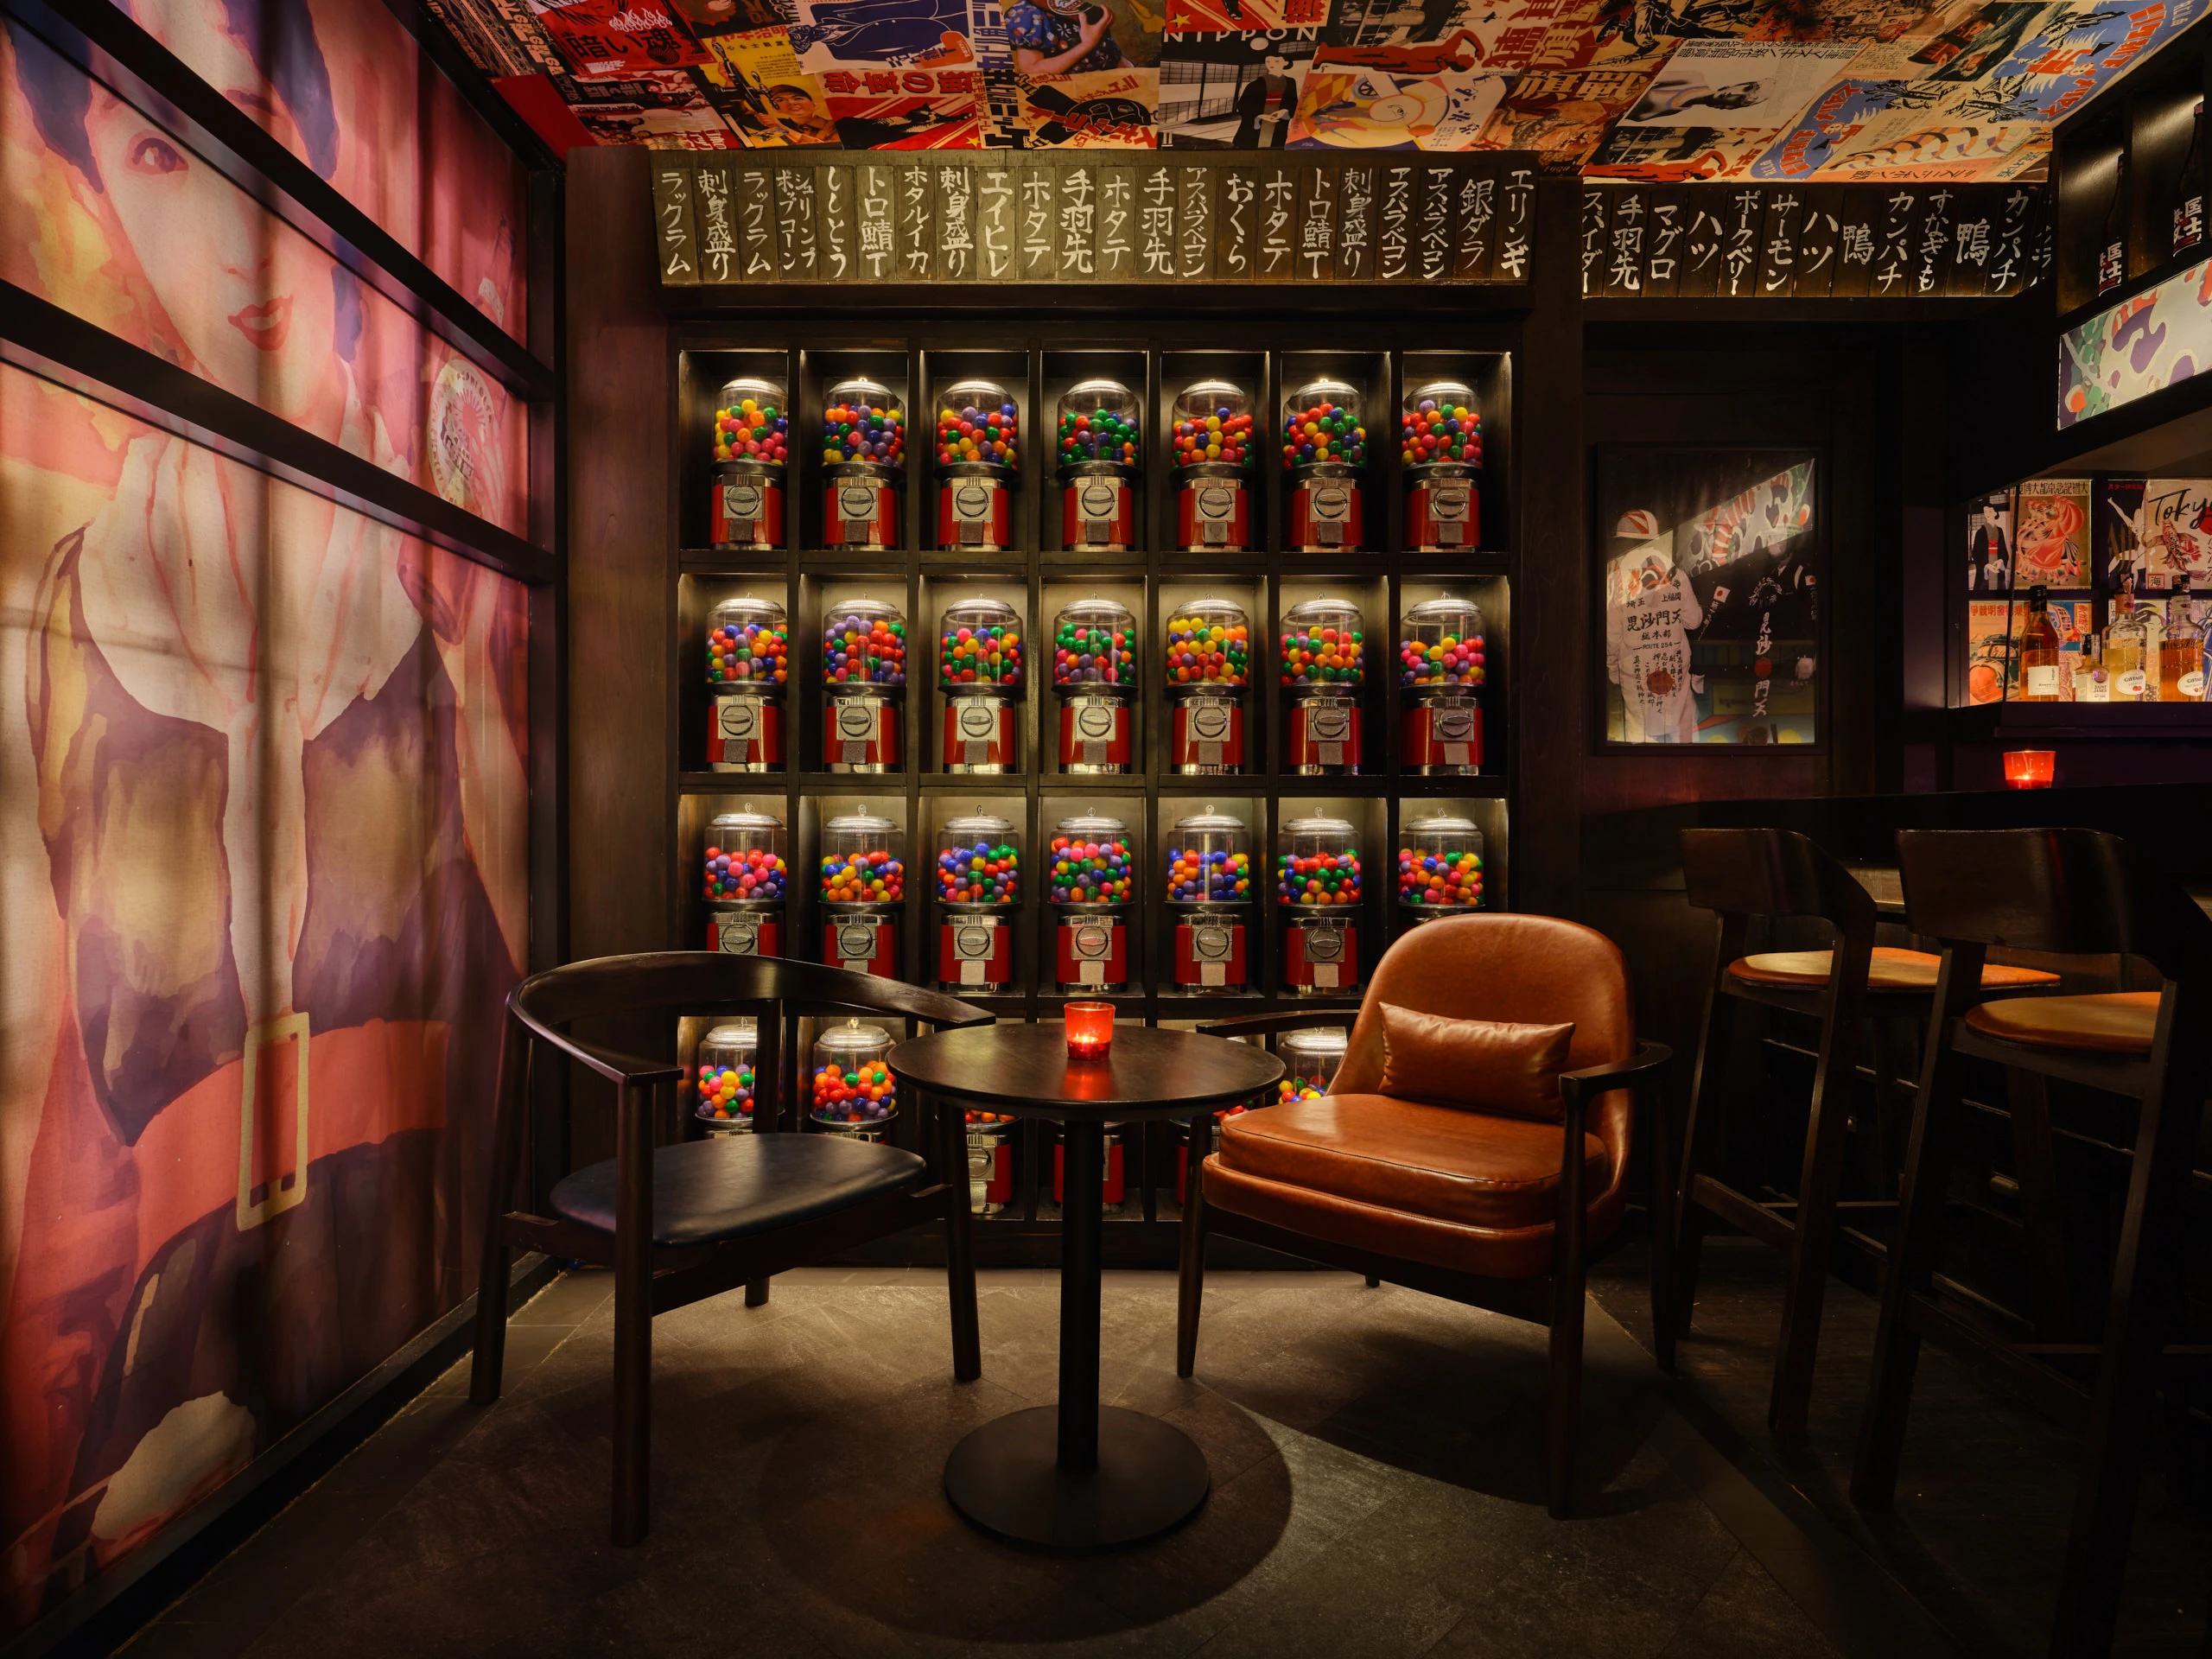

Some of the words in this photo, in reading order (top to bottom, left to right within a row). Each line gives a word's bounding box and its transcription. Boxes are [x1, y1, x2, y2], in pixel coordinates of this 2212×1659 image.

[661, 172, 691, 276] ラックラム
[697, 169, 736, 282] 刺身盛り
[743, 171, 772, 275] ラックラム
[827, 166, 847, 278] ししとう
[902, 166, 930, 274] ホタルイカ
[940, 166, 974, 277] 刺身盛り
[981, 172, 1014, 277] エイヒレ
[1023, 171, 1051, 269] ホタテ
[1060, 168, 1095, 273] 手羽先
[1102, 175, 1131, 270] ホタテ
[1141, 168, 1174, 275] 手羽先
[1227, 173, 1255, 274] おくら
[1262, 170, 1293, 273] ホタテ
[1341, 168, 1372, 277] 刺身盛り
[1382, 168, 1412, 278] アスパラベーコン
[1421, 168, 1453, 278] アスパラベーコン
[1459, 179, 1494, 270] 銀ダラ
[1501, 169, 1534, 278] エリンギ
[1609, 194, 1643, 290] 手羽先
[1651, 205, 1684, 279] マグロ
[1688, 211, 1723, 272] ハツ
[1765, 194, 1799, 291] サーモン
[1802, 212, 1840, 274] ハツ
[1842, 222, 1875, 265] 鴨
[1878, 191, 1915, 295] カンパチ
[1918, 189, 1954, 293] すなぎも
[1956, 218, 1990, 266] 鴨
[1991, 189, 2029, 292] カンパチ
[2148, 488, 2212, 529] Toky
[1626, 597, 1646, 609] 埼玉
[1627, 608, 1681, 632] 毘沙門天
